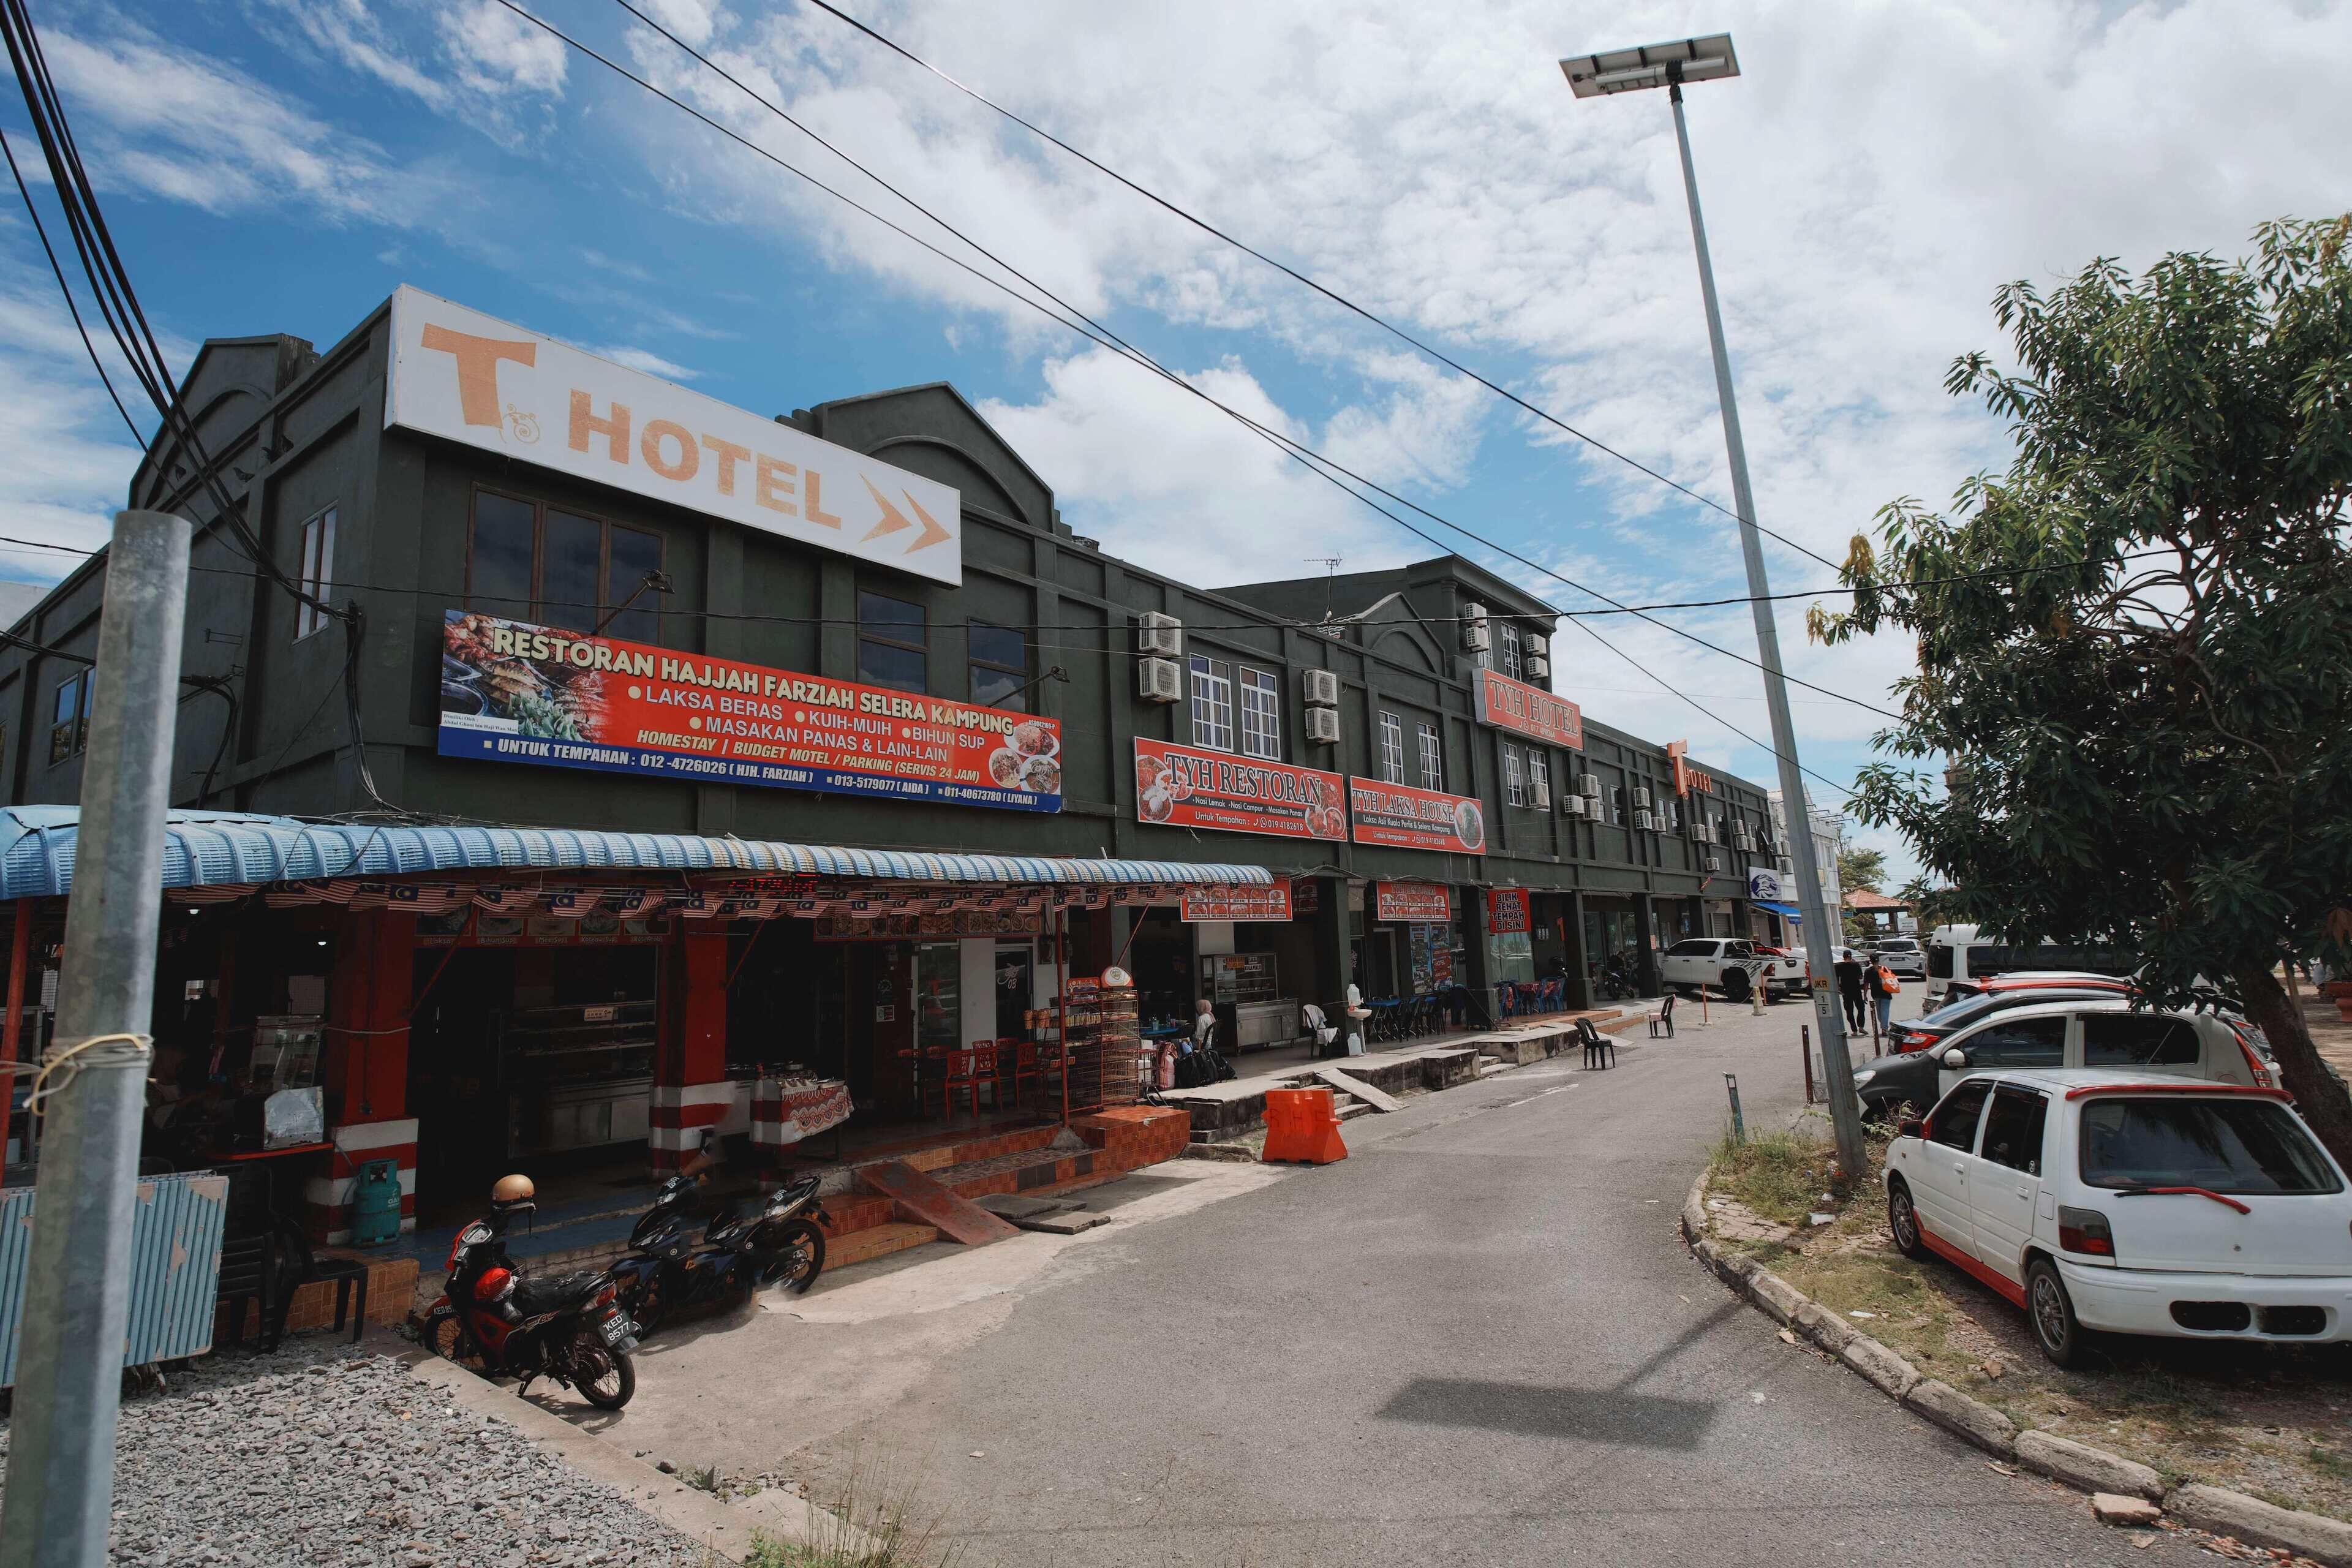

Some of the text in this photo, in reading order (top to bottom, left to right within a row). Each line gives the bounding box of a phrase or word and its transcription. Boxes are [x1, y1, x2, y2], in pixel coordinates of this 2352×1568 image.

[421, 322, 842, 531] T HOTEL
[494, 627, 1014, 736] RESTORAN HAJJAH FARZIAH SELERA KAMPUNG
[1489, 677, 1578, 736] TYH HOTEL
[646, 685, 986, 750] LAKSA BERAS KUIH-MUIH BIHUN SUP
[706, 716, 948, 762] MASAKAN PANAS & LAIN-LAIN
[497, 738, 550, 757] UNTUK
[552, 744, 629, 765] TEMPAHAN
[640, 754, 665, 768] 012
[666, 757, 727, 775] -4726026
[763, 767, 806, 782] FARZIAH
[636, 729, 717, 752] HOMESTAY
[733, 741, 788, 759] BUDGET
[788, 748, 830, 764] MOTEL
[842, 755, 892, 772] PARKING
[895, 761, 937, 777] (SERVIS
[938, 767, 952, 778] 24
[954, 769, 979, 784] JAM)
[834, 774, 895, 791] 013-5179077
[901, 780, 922, 793] AIDA
[1164, 752, 1322, 807] TYH RESTORAN
[1684, 766, 1713, 793] HOTEL
[944, 786, 1001, 802] 011-40673780
[1007, 793, 1032, 805] LIYANA
[1352, 788, 1455, 823] TYH LAKSA HOUSE
[1195, 796, 1207, 805] Nasi
[1208, 797, 1226, 807] Lemak
[1243, 802, 1263, 812] Campur
[1268, 806, 1289, 815] Masakan
[1289, 808, 1303, 817] Panas
[1195, 810, 1214, 821] Untuk
[1215, 813, 1246, 826] Tempahan
[1268, 820, 1279, 829] 019
[1280, 821, 1304, 831] 4182618
[1363, 814, 1377, 824] Laksa
[1387, 817, 1400, 827] Kuala
[1417, 821, 1431, 831] Selera
[1431, 824, 1450, 834] Kampung
[1496, 892, 1518, 902] BILIK
[1496, 902, 1522, 911] REHAT
[1491, 911, 1525, 921] TEMPAH
[1496, 920, 1524, 930] DI SINI
[605, 1315, 623, 1332] KED
[608, 1322, 629, 1341] 8577
